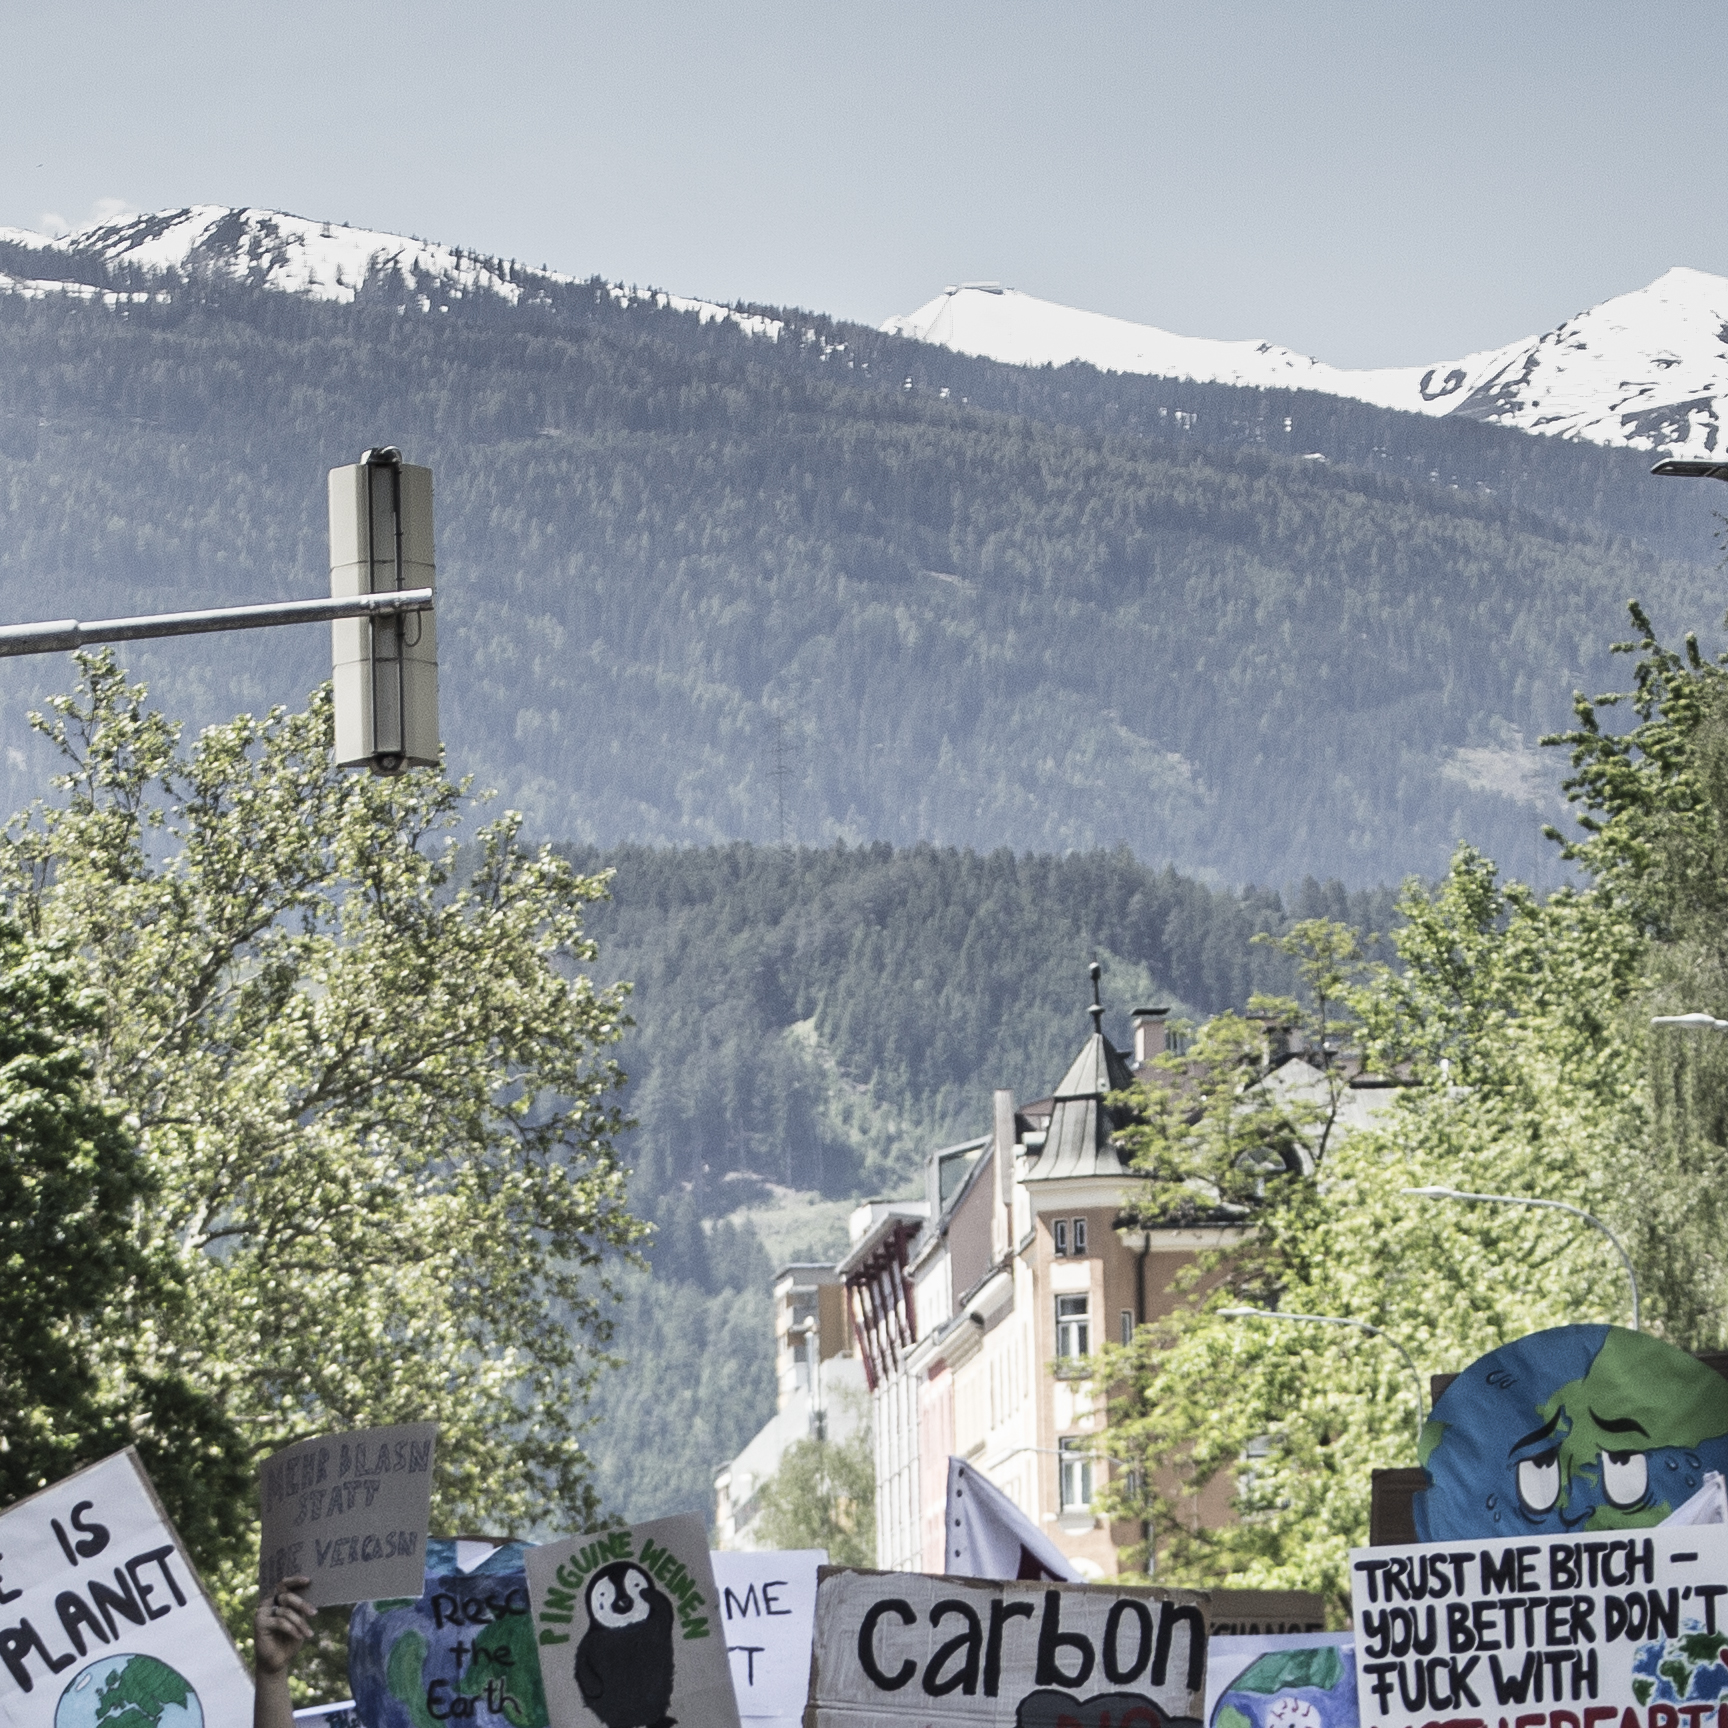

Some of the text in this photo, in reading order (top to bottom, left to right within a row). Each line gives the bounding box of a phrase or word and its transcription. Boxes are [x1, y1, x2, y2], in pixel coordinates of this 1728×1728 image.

[51, 1500, 111, 1566] IS
[539, 1531, 710, 1645] PINGUINE WEINEN
[1356, 1552, 1475, 1604] TRUST
[1480, 1546, 1539, 1594] ME
[1548, 1540, 1655, 1592] BITCH
[448, 1639, 515, 1669] the
[1362, 1583, 1728, 1660] YOU BETTER DON'T
[426, 1677, 522, 1720] Earth
[1363, 1649, 1599, 1715] FUCK WITH
